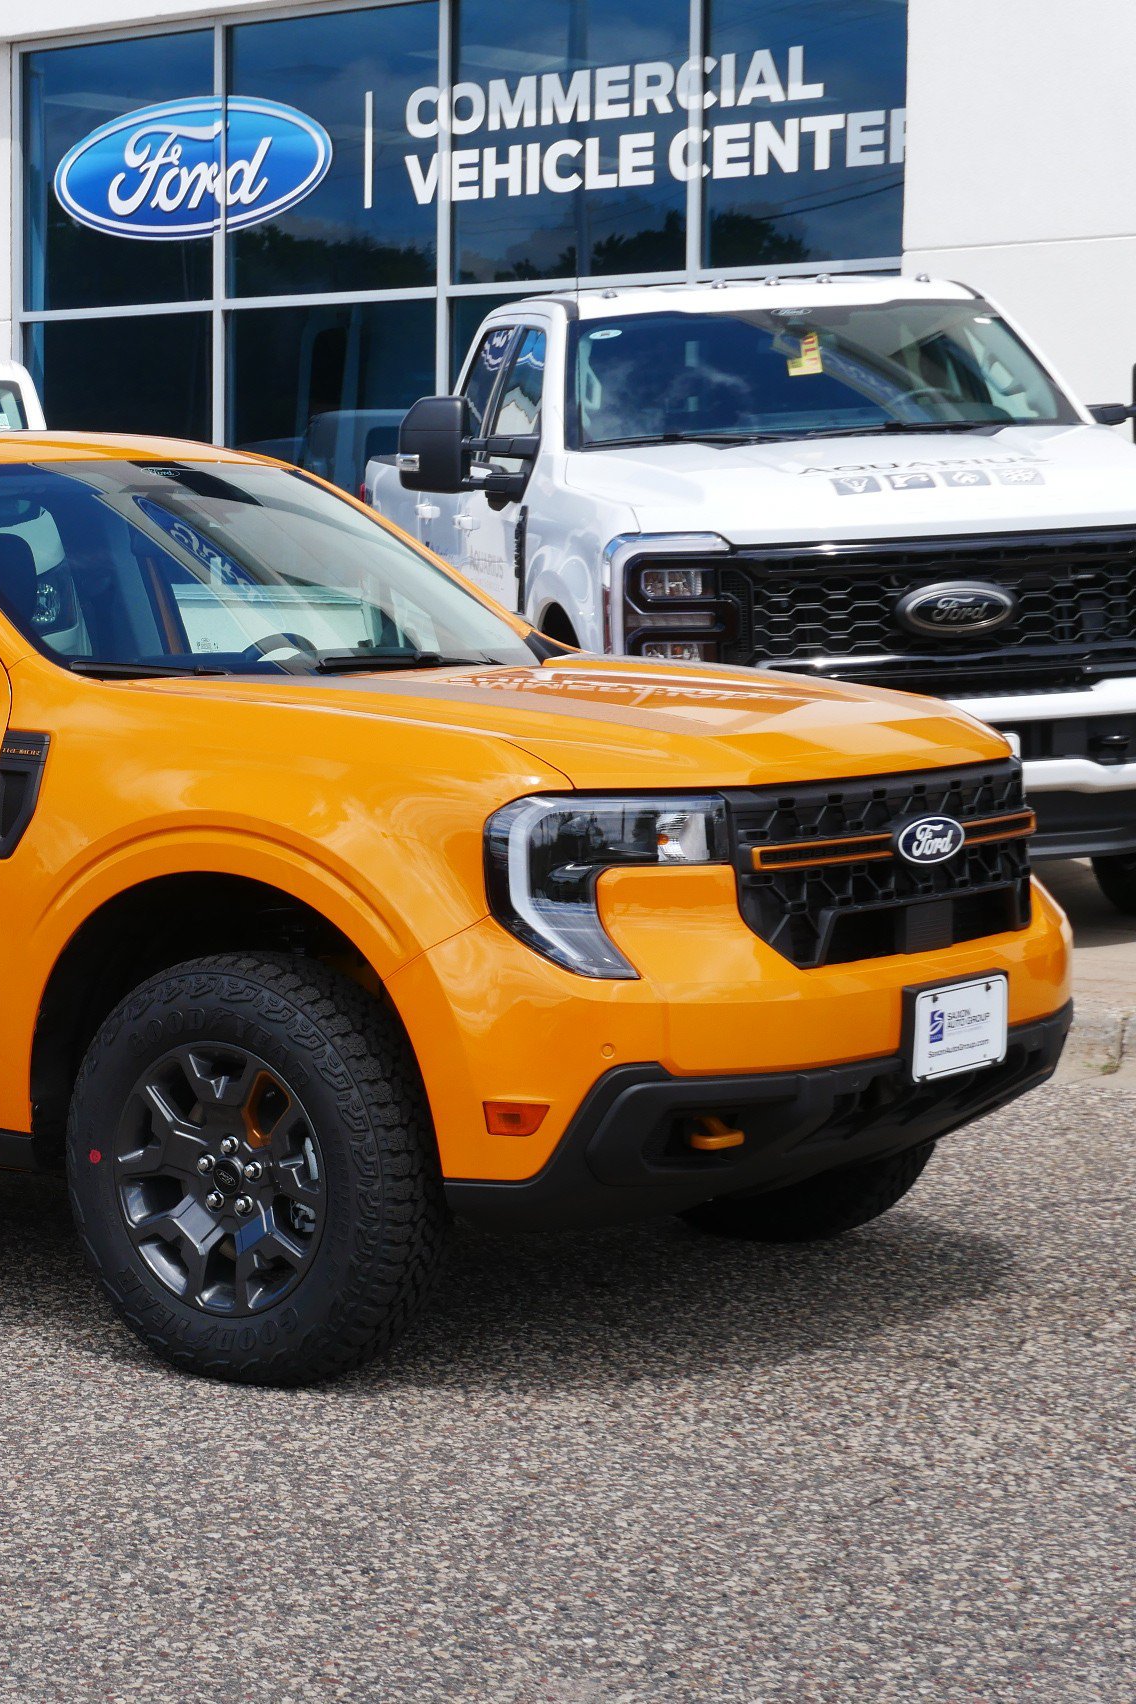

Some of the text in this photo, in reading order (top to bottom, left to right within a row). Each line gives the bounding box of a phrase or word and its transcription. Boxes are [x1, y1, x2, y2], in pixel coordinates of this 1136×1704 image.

[405, 45, 825, 139] COMMERCIAL
[108, 119, 273, 217] Ford
[404, 131, 655, 205] VEHICLE
[798, 457, 1050, 475] AQUARIUS
[931, 596, 990, 622] Ford
[911, 823, 954, 857] Ford
[966, 1012, 991, 1026] GROUP
